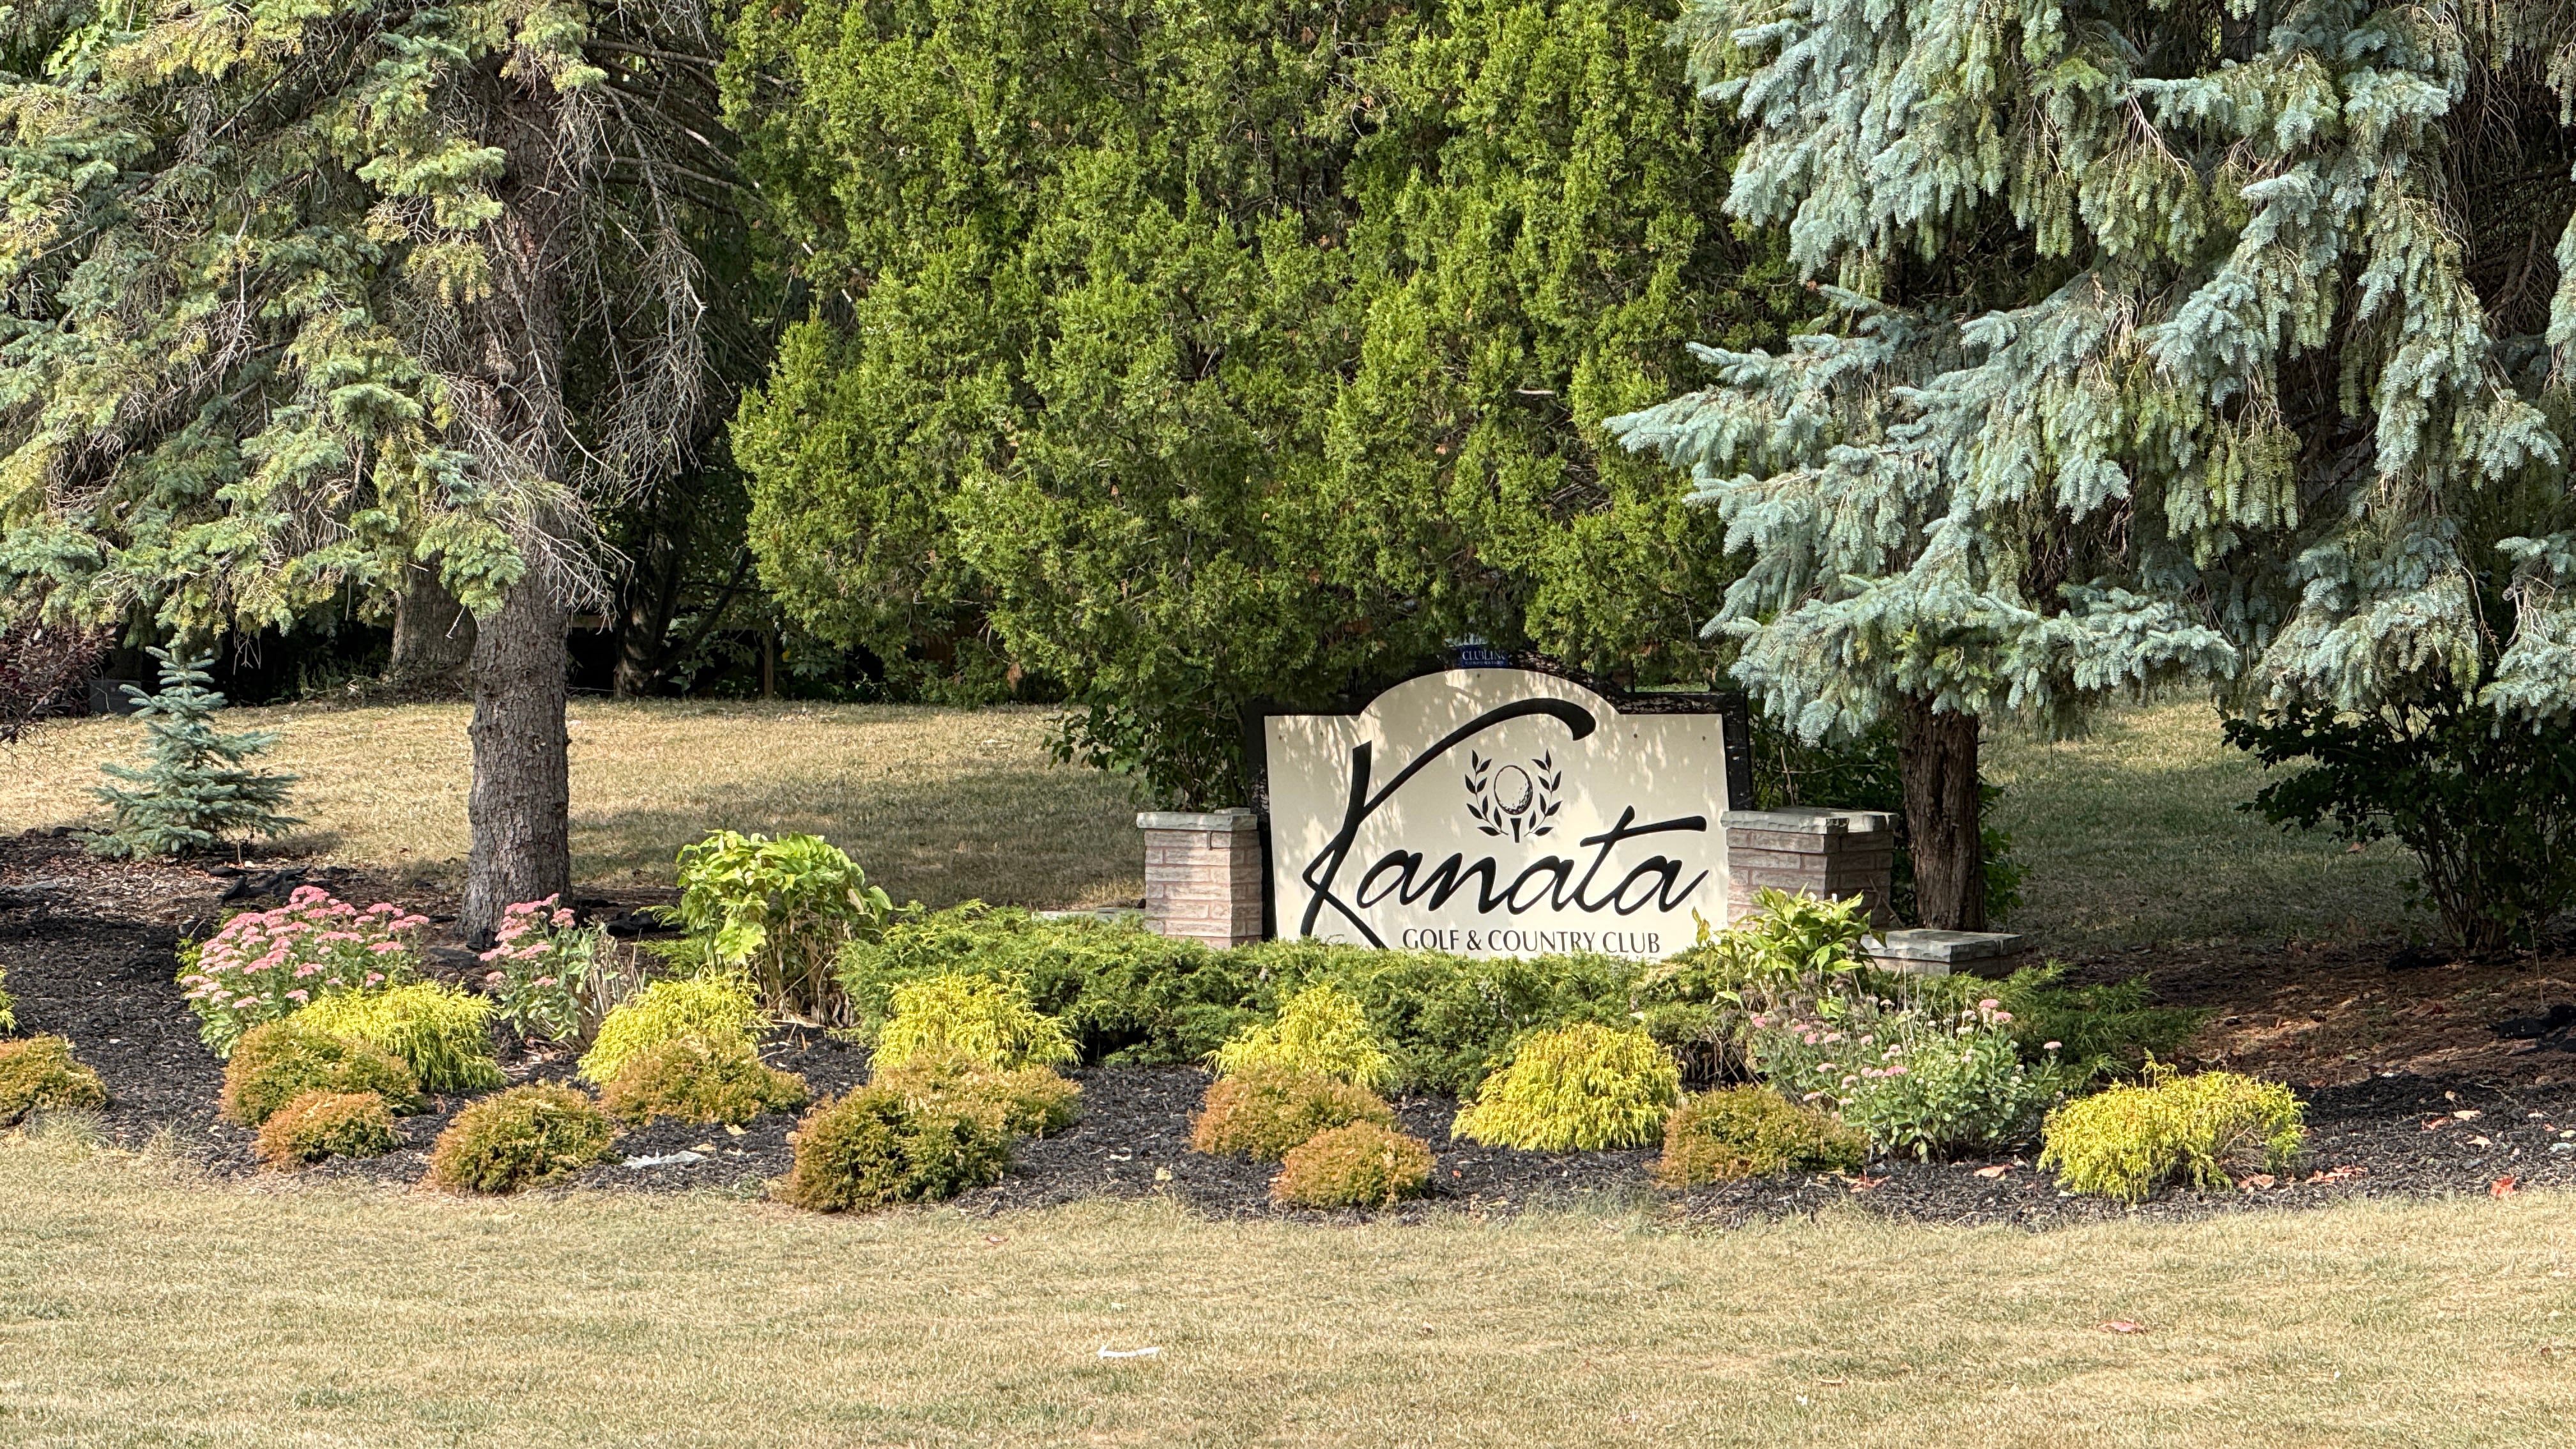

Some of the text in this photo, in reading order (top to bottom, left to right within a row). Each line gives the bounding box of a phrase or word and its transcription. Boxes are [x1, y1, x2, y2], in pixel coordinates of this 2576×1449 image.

[1300, 698, 1709, 951] Kanata
[1402, 928, 1660, 953] GOLF & COUNTRY CLUB
